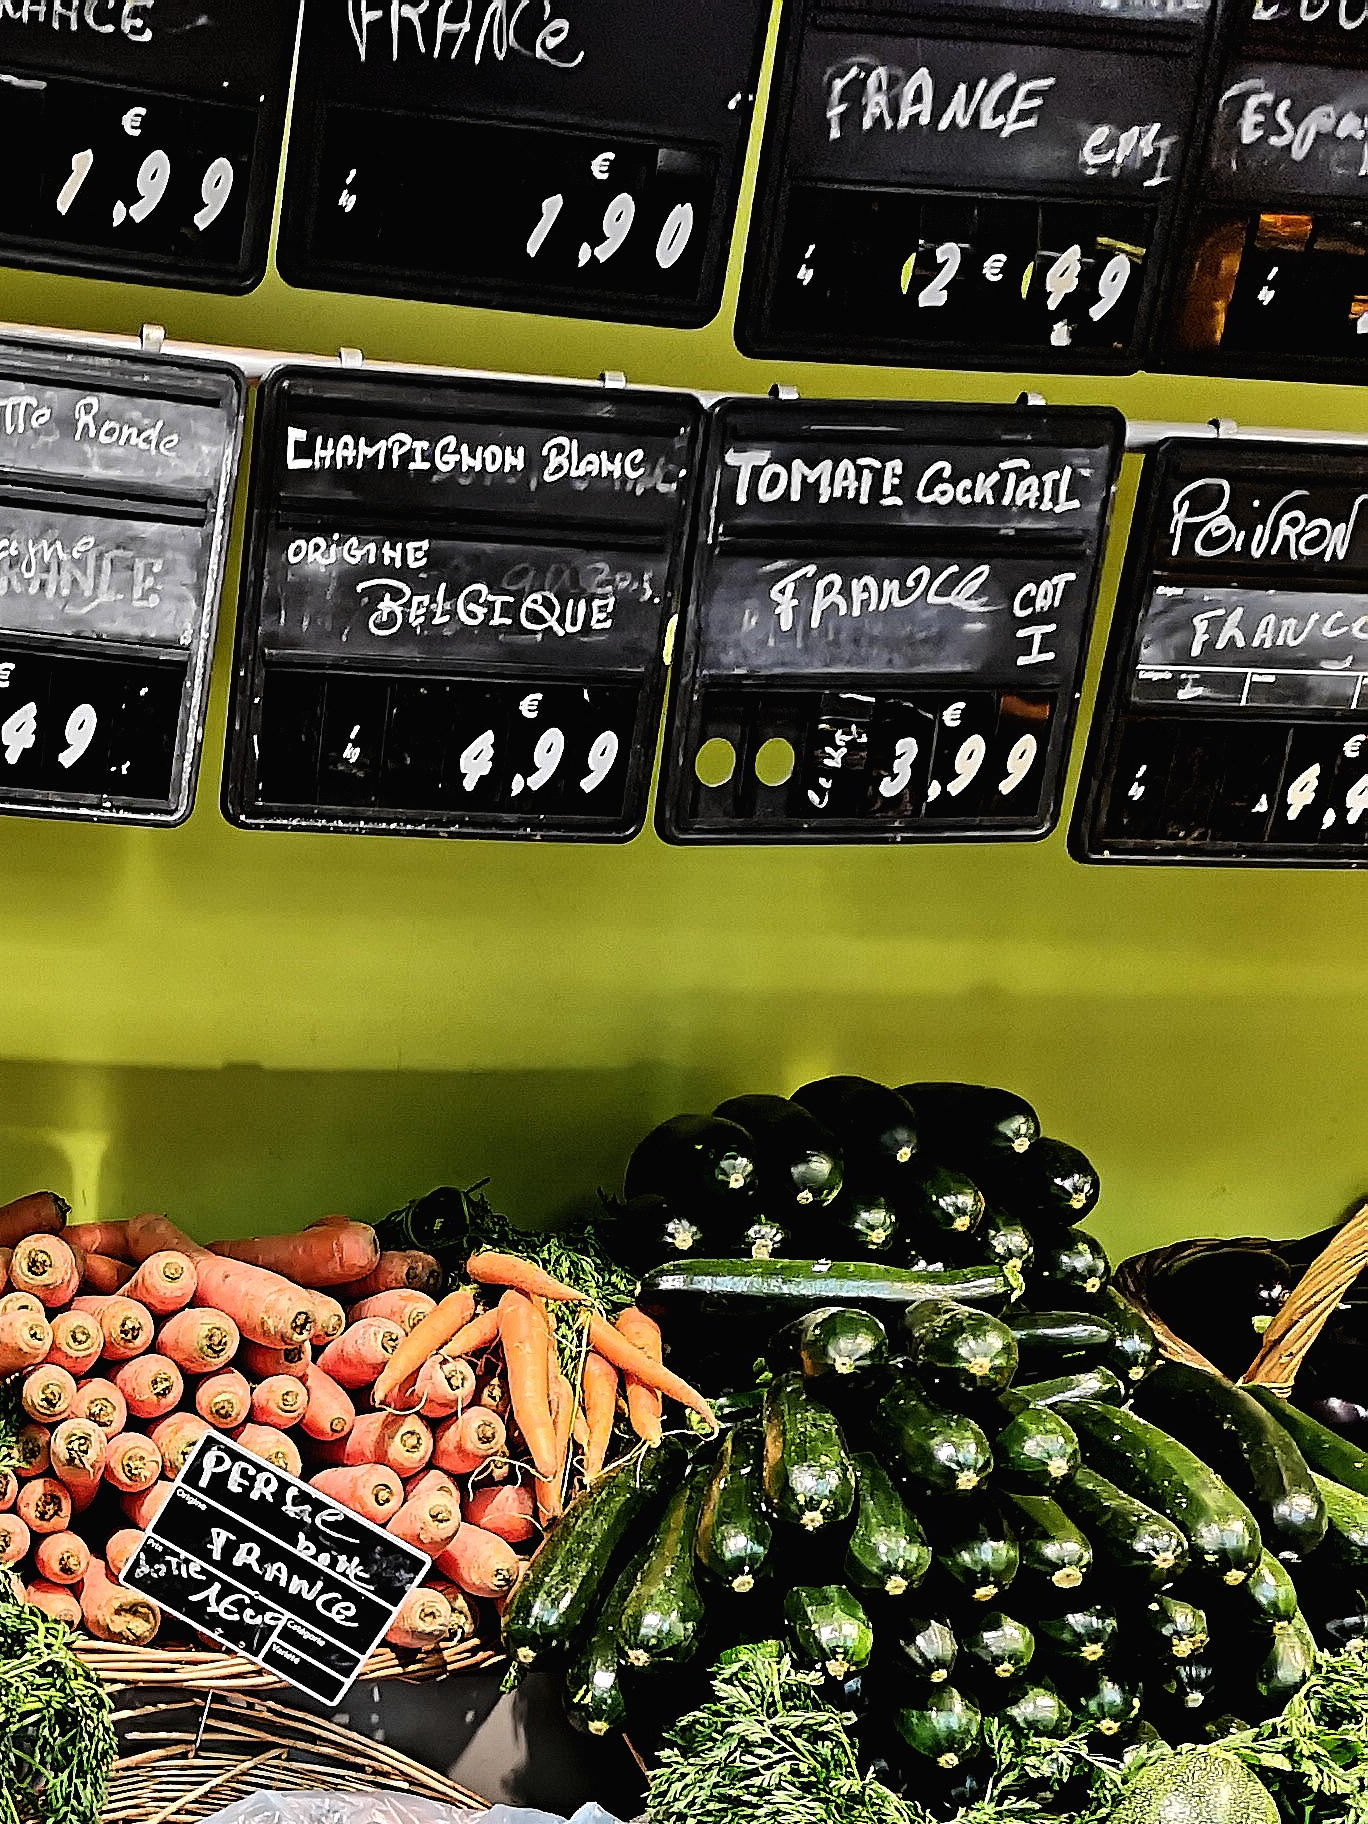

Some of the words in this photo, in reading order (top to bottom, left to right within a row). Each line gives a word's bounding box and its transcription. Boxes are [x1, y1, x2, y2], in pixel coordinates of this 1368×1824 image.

[825, 65, 1056, 140] FRANCE
[56, 149, 233, 231] 1,99
[526, 192, 694, 268] 1,90
[74, 396, 180, 457] Ronde
[287, 426, 524, 470] CHAMPIGNON
[725, 449, 903, 507] TOMATE
[356, 578, 615, 636] BELGIQUE
[1013, 572, 1076, 616] CAT
[460, 727, 619, 797] 4,99
[879, 733, 1037, 802] 3,99
